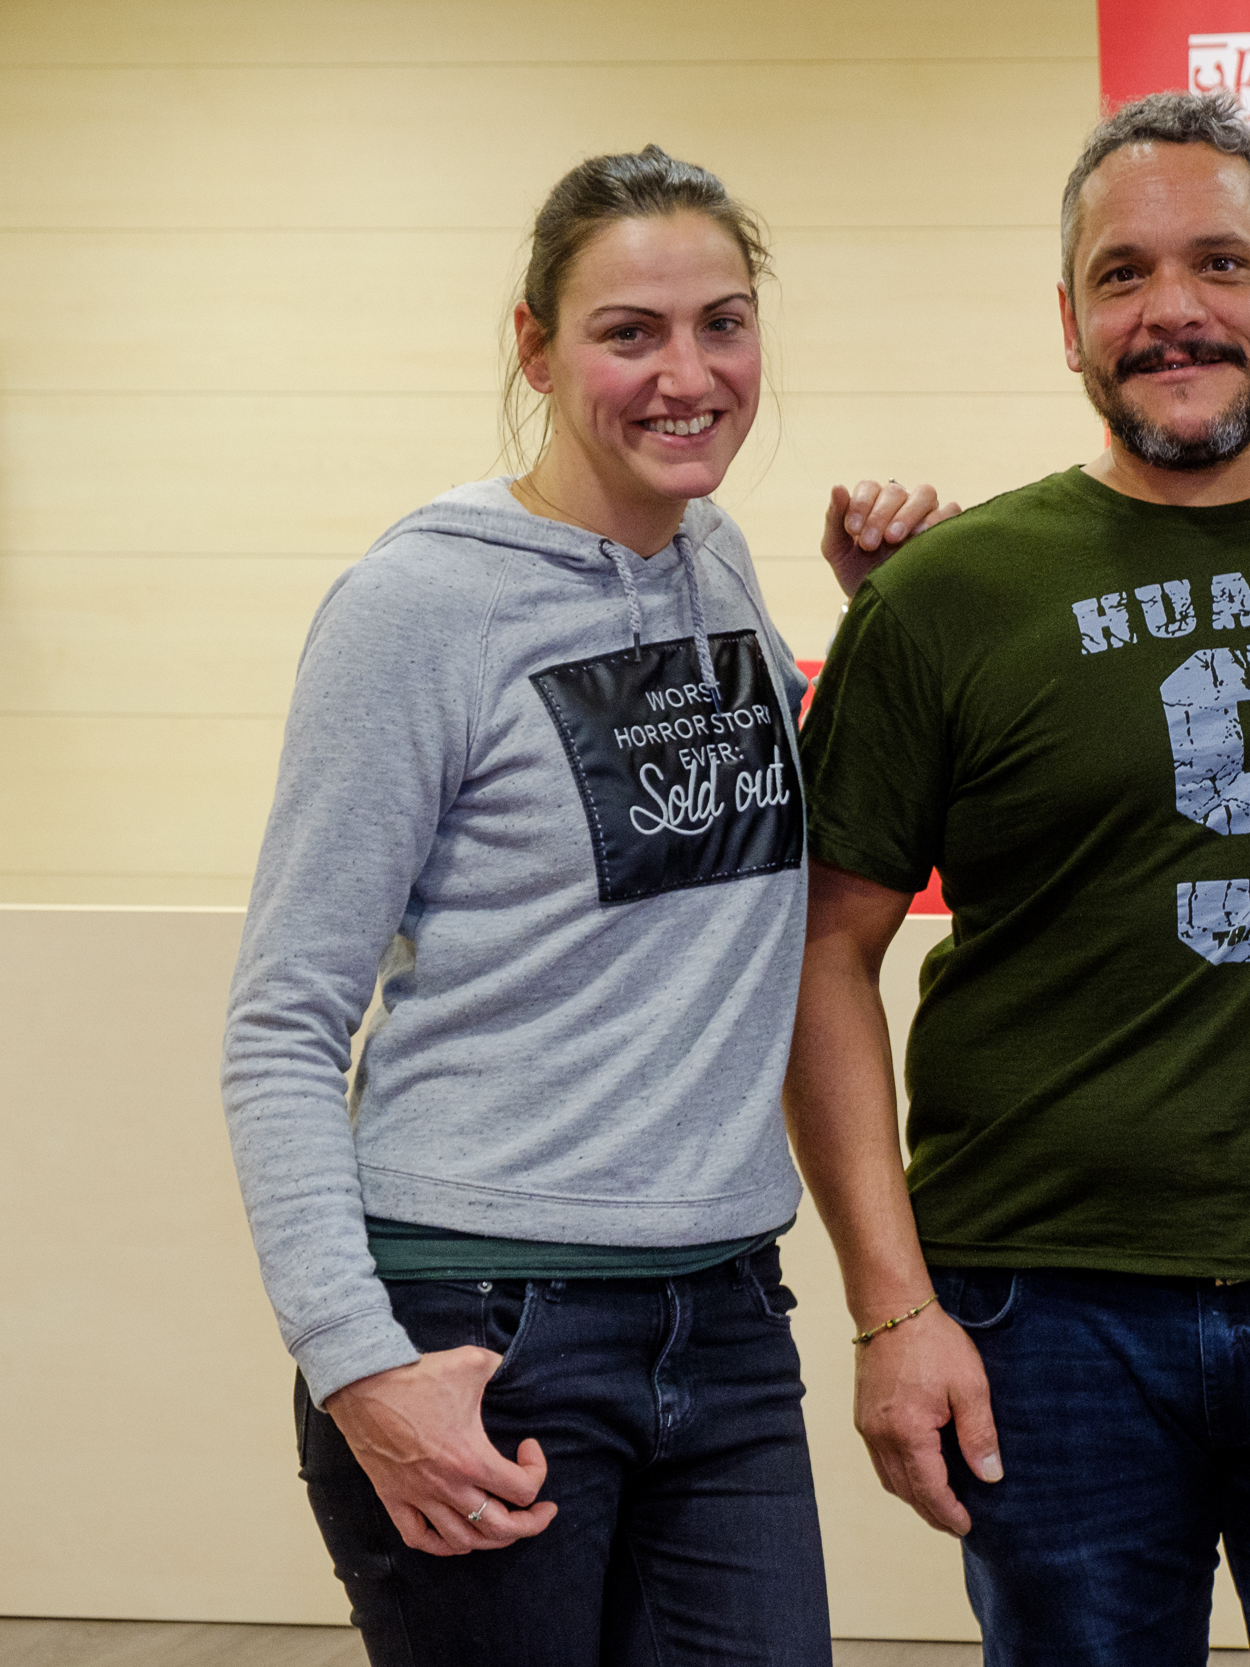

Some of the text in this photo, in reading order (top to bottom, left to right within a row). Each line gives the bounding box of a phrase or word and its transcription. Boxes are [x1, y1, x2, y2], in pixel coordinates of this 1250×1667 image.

[645, 682, 721, 711] WORST
[614, 715, 709, 749] HORROR
[678, 742, 744, 770] EVER:
[630, 745, 790, 835] Sold out
